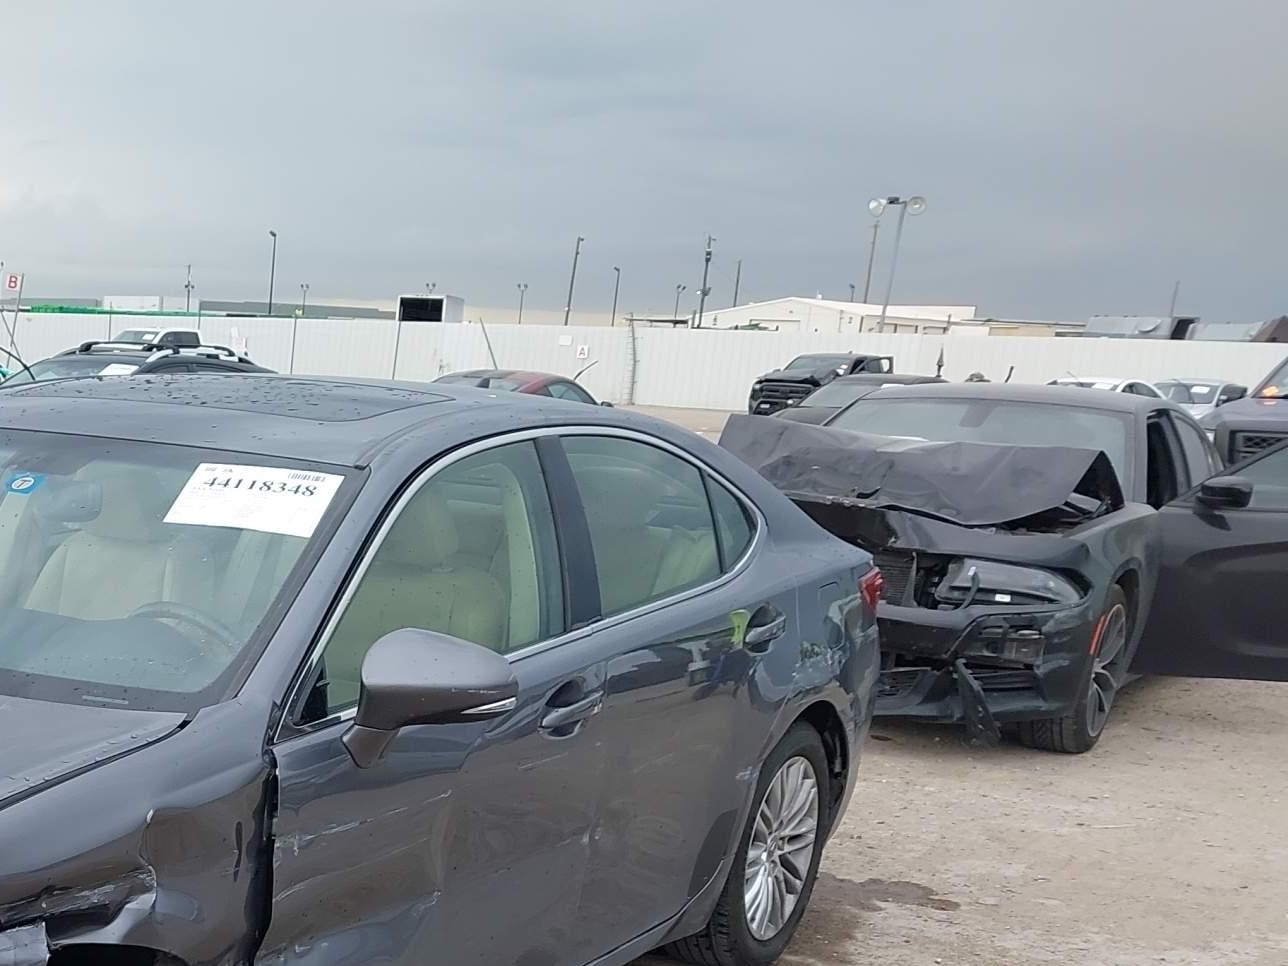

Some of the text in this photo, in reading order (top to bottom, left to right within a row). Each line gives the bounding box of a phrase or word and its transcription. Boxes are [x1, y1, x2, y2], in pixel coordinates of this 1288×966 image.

[8, 275, 18, 289] B
[578, 346, 586, 357] A
[203, 476, 317, 497] 44118348
